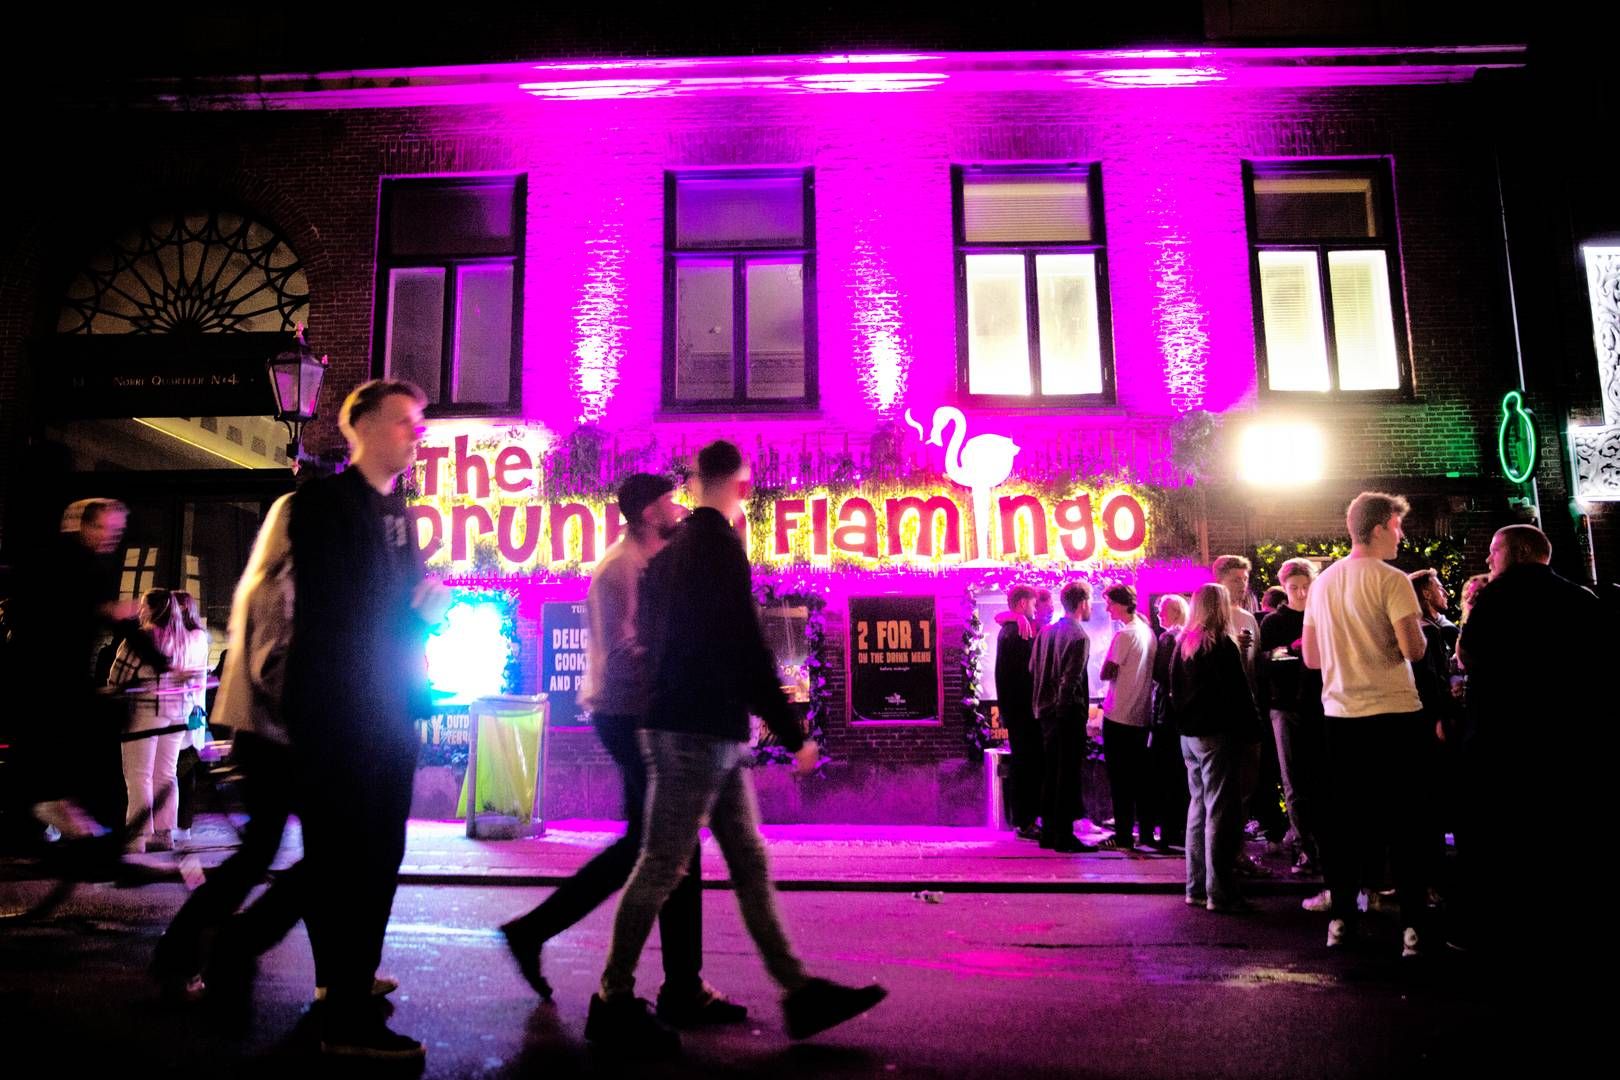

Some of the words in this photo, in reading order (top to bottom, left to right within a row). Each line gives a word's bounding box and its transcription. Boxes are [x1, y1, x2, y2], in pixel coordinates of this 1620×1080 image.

[416, 435, 532, 498] The
[407, 503, 630, 563] Drun
[773, 494, 1146, 562] Flamingo
[552, 628, 590, 649] DELIC
[857, 621, 868, 650] 2
[876, 620, 912, 650] FOR
[919, 620, 930, 649] 1
[858, 652, 868, 664] ON
[870, 652, 884, 664] THE
[886, 651, 908, 664] DRINK
[911, 651, 931, 663] MENU
[549, 676, 570, 691] AND
